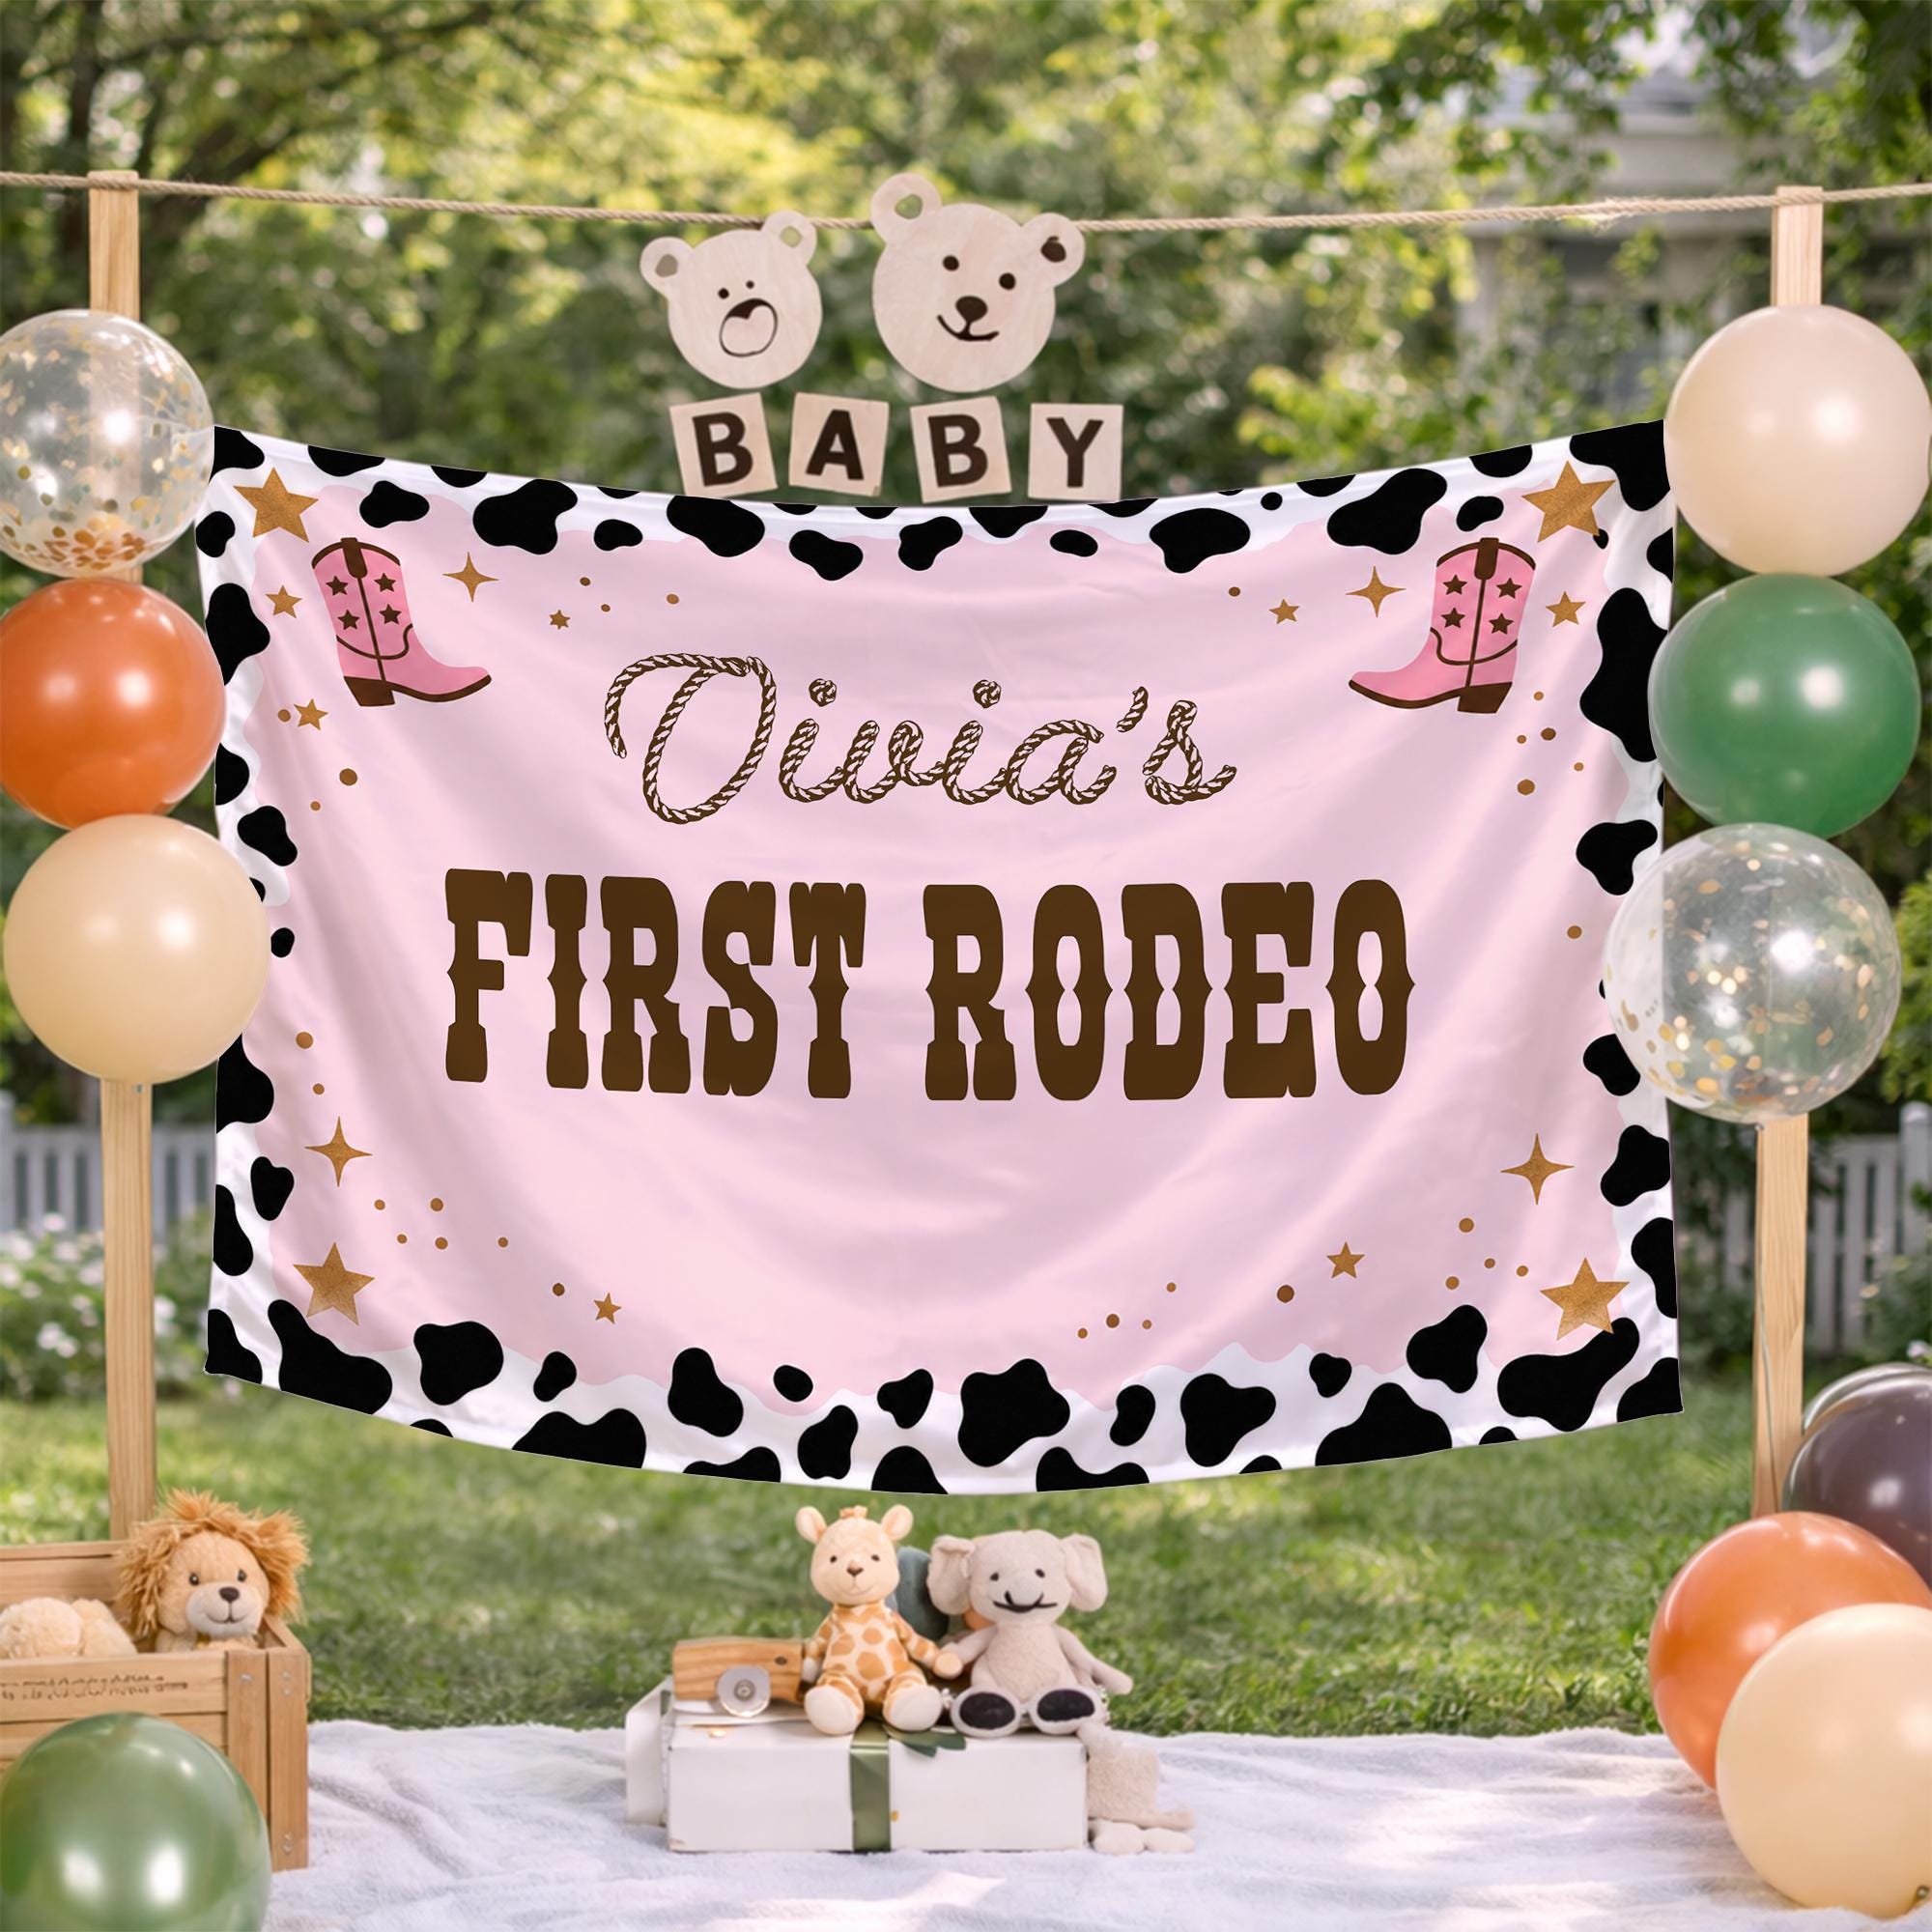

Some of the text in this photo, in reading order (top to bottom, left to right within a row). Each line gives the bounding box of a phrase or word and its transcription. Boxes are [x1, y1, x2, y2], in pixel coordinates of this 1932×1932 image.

[693, 410, 1104, 488] BABY
[445, 868, 1415, 1101] FIRST RODEO
